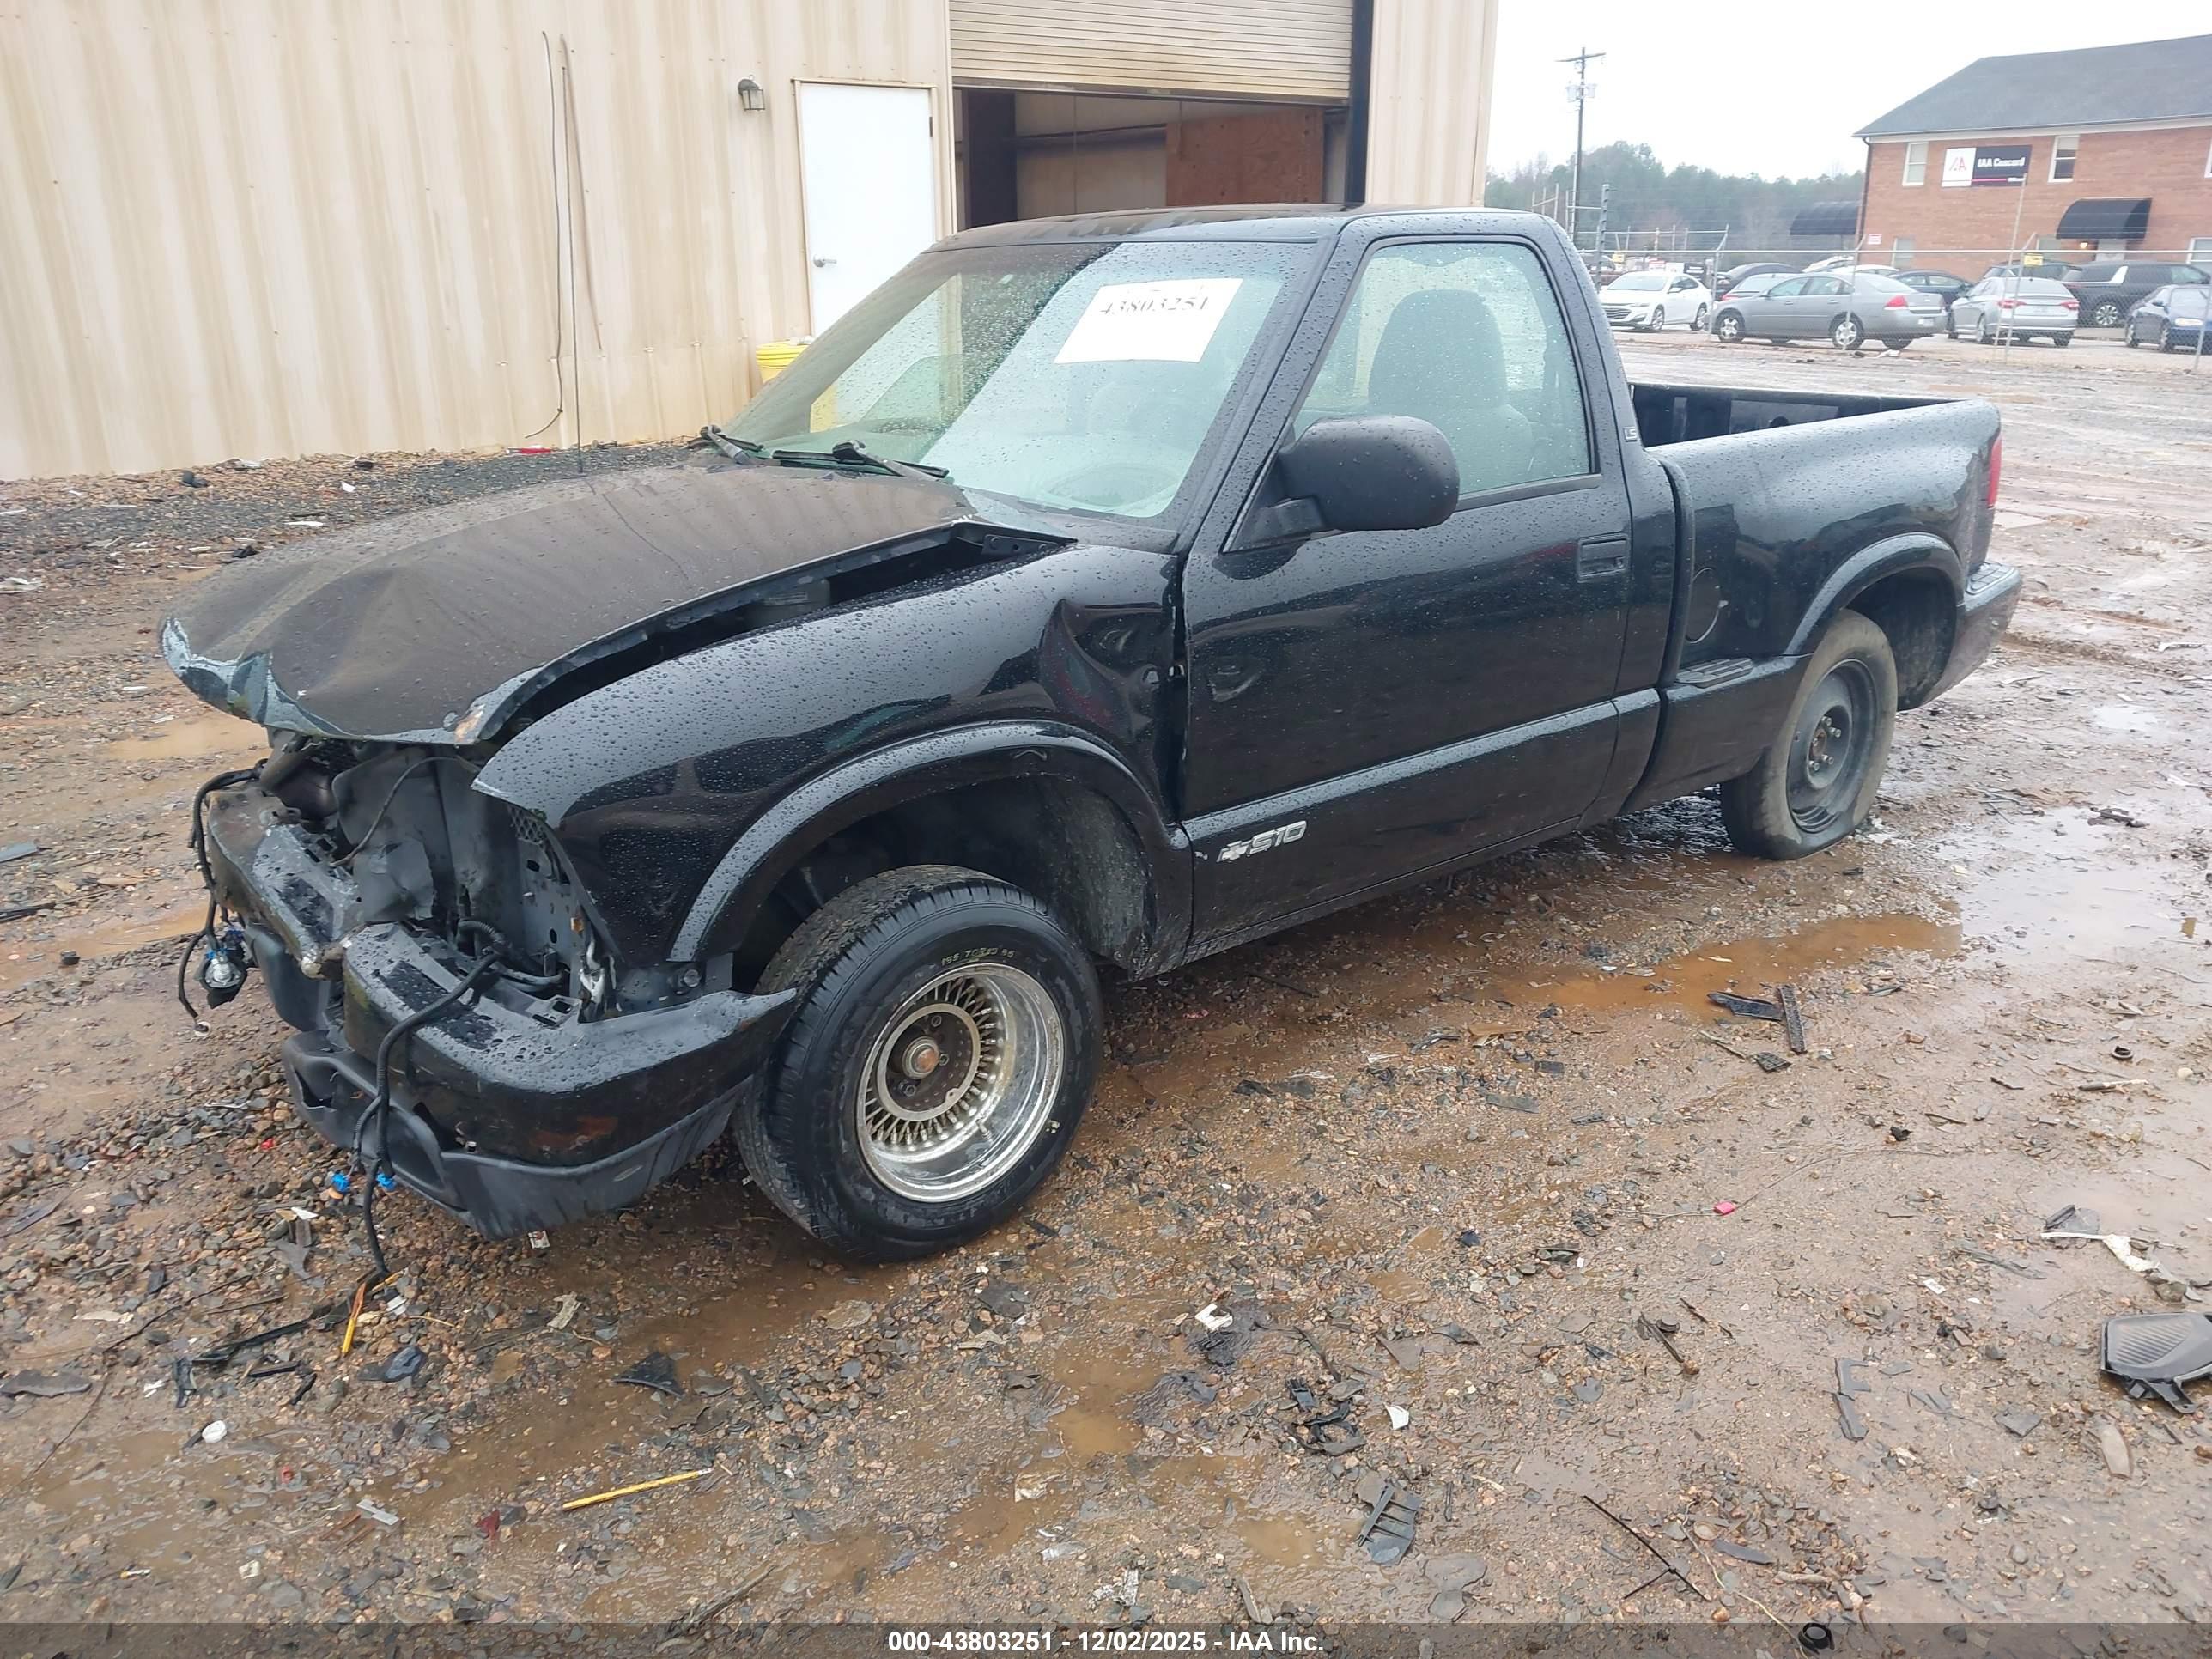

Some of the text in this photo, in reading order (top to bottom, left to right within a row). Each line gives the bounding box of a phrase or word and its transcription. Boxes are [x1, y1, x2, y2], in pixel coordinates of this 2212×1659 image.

[1978, 158, 1993, 167] IAA
[1100, 296, 1208, 314] 43803251
[1249, 821, 1307, 855] S10
